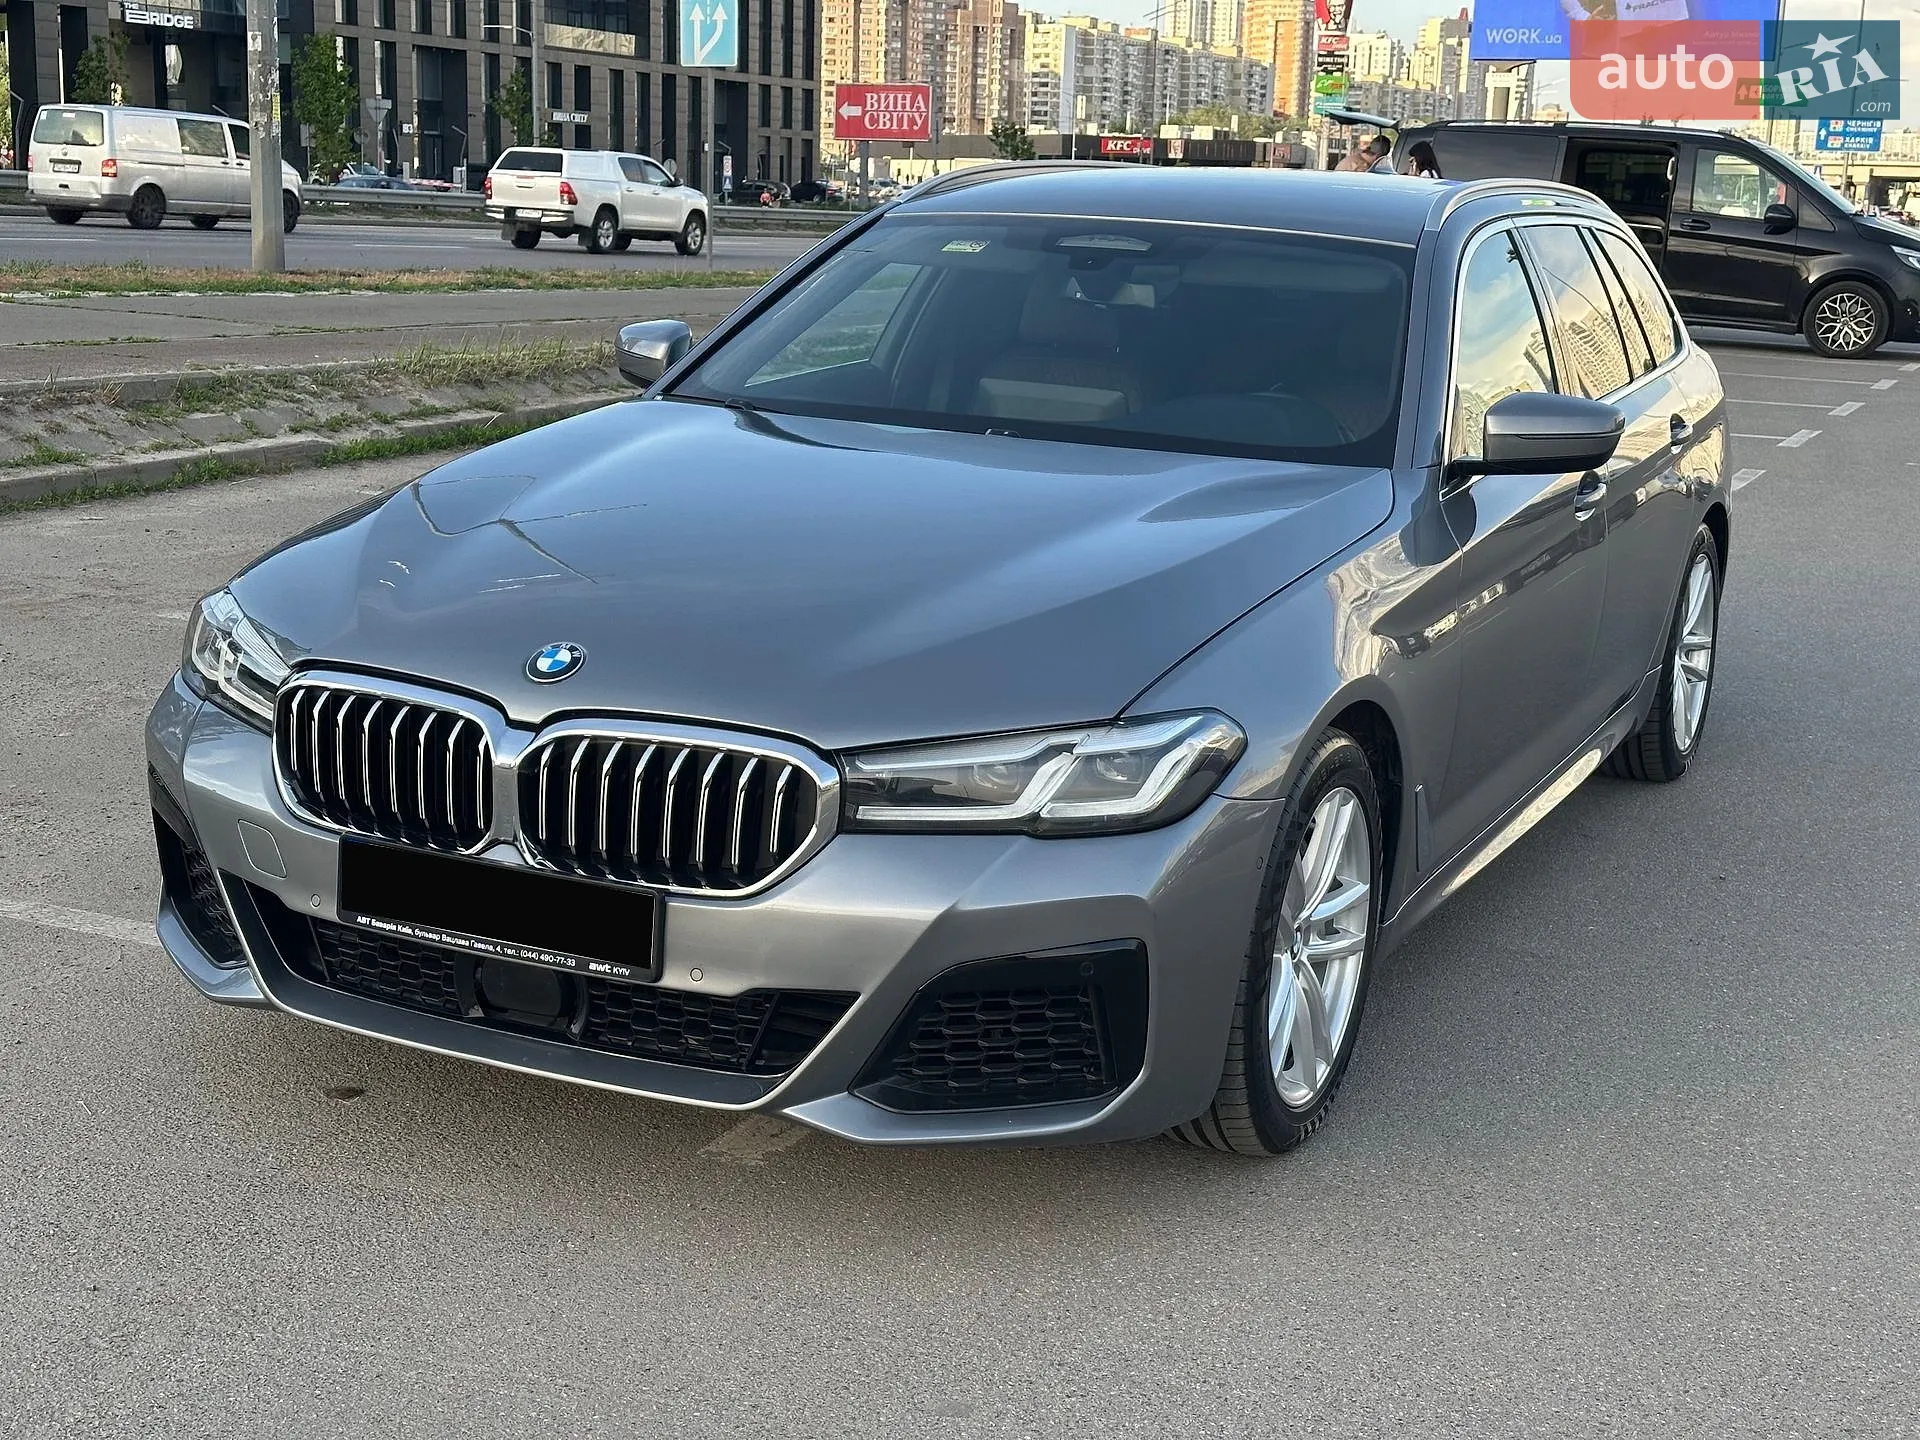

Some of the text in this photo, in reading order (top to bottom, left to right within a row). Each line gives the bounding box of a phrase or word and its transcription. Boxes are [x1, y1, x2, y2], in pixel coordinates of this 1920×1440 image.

[123, 2, 139, 10] THE
[1486, 28, 1562, 44] WORK.ua
[863, 92, 927, 112] ВИНА
[864, 111, 927, 131] СВІТУ
[1106, 140, 1132, 151] KFC
[1844, 136, 1874, 144] ХАРКІВ
[520, 950, 539, 960] (044)
[539, 954, 576, 967] 490-77-33
[588, 962, 631, 976] awt KYIV
